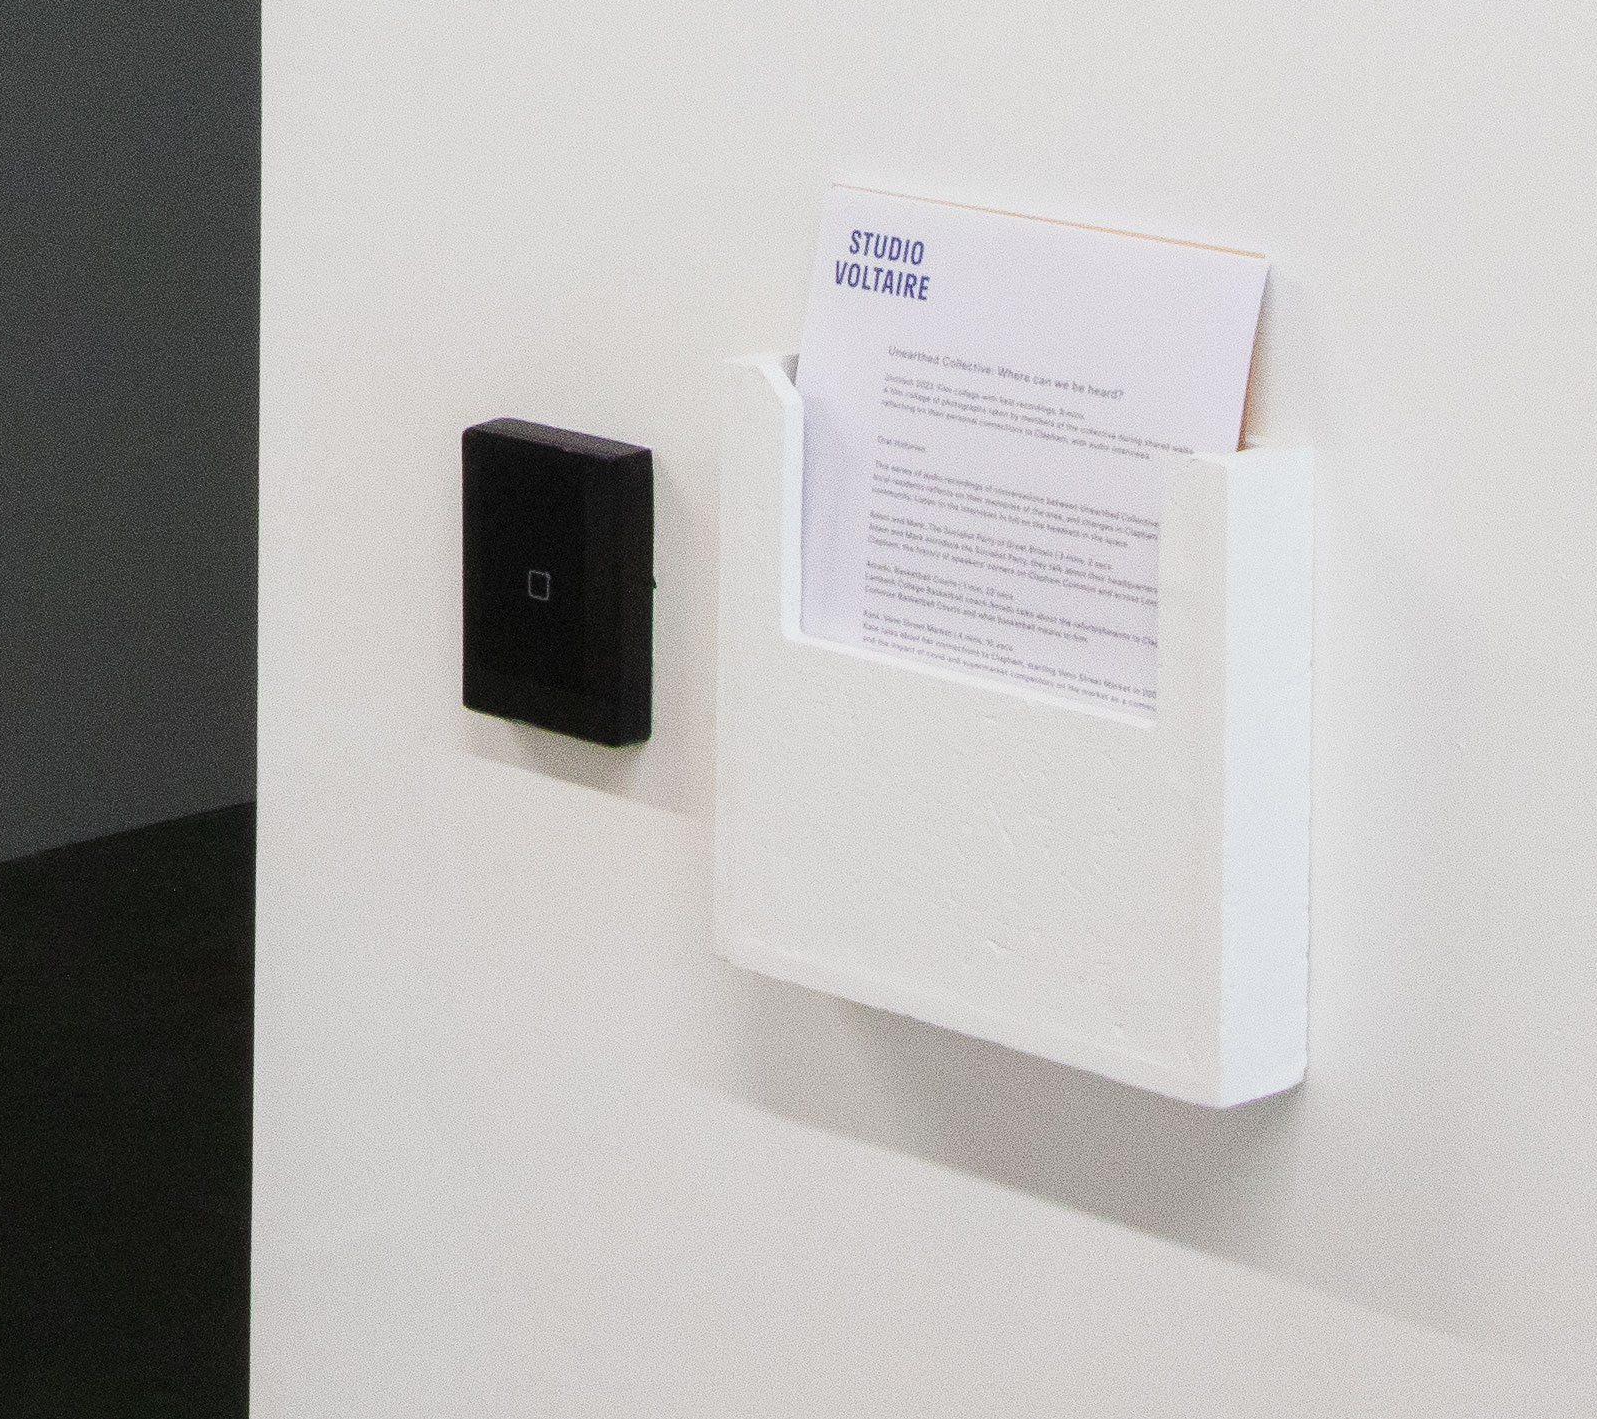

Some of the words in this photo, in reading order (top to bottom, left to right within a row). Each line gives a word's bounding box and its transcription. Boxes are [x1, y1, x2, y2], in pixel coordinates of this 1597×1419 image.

[848, 229, 926, 266] STUDIO
[834, 260, 930, 301] VOLTAIRE
[888, 345, 939, 365] Unearthed
[997, 367, 1030, 383] Where
[1033, 376, 1051, 387] can
[1054, 380, 1068, 390] we
[1071, 382, 1084, 394] be
[1087, 385, 1124, 401] heard?
